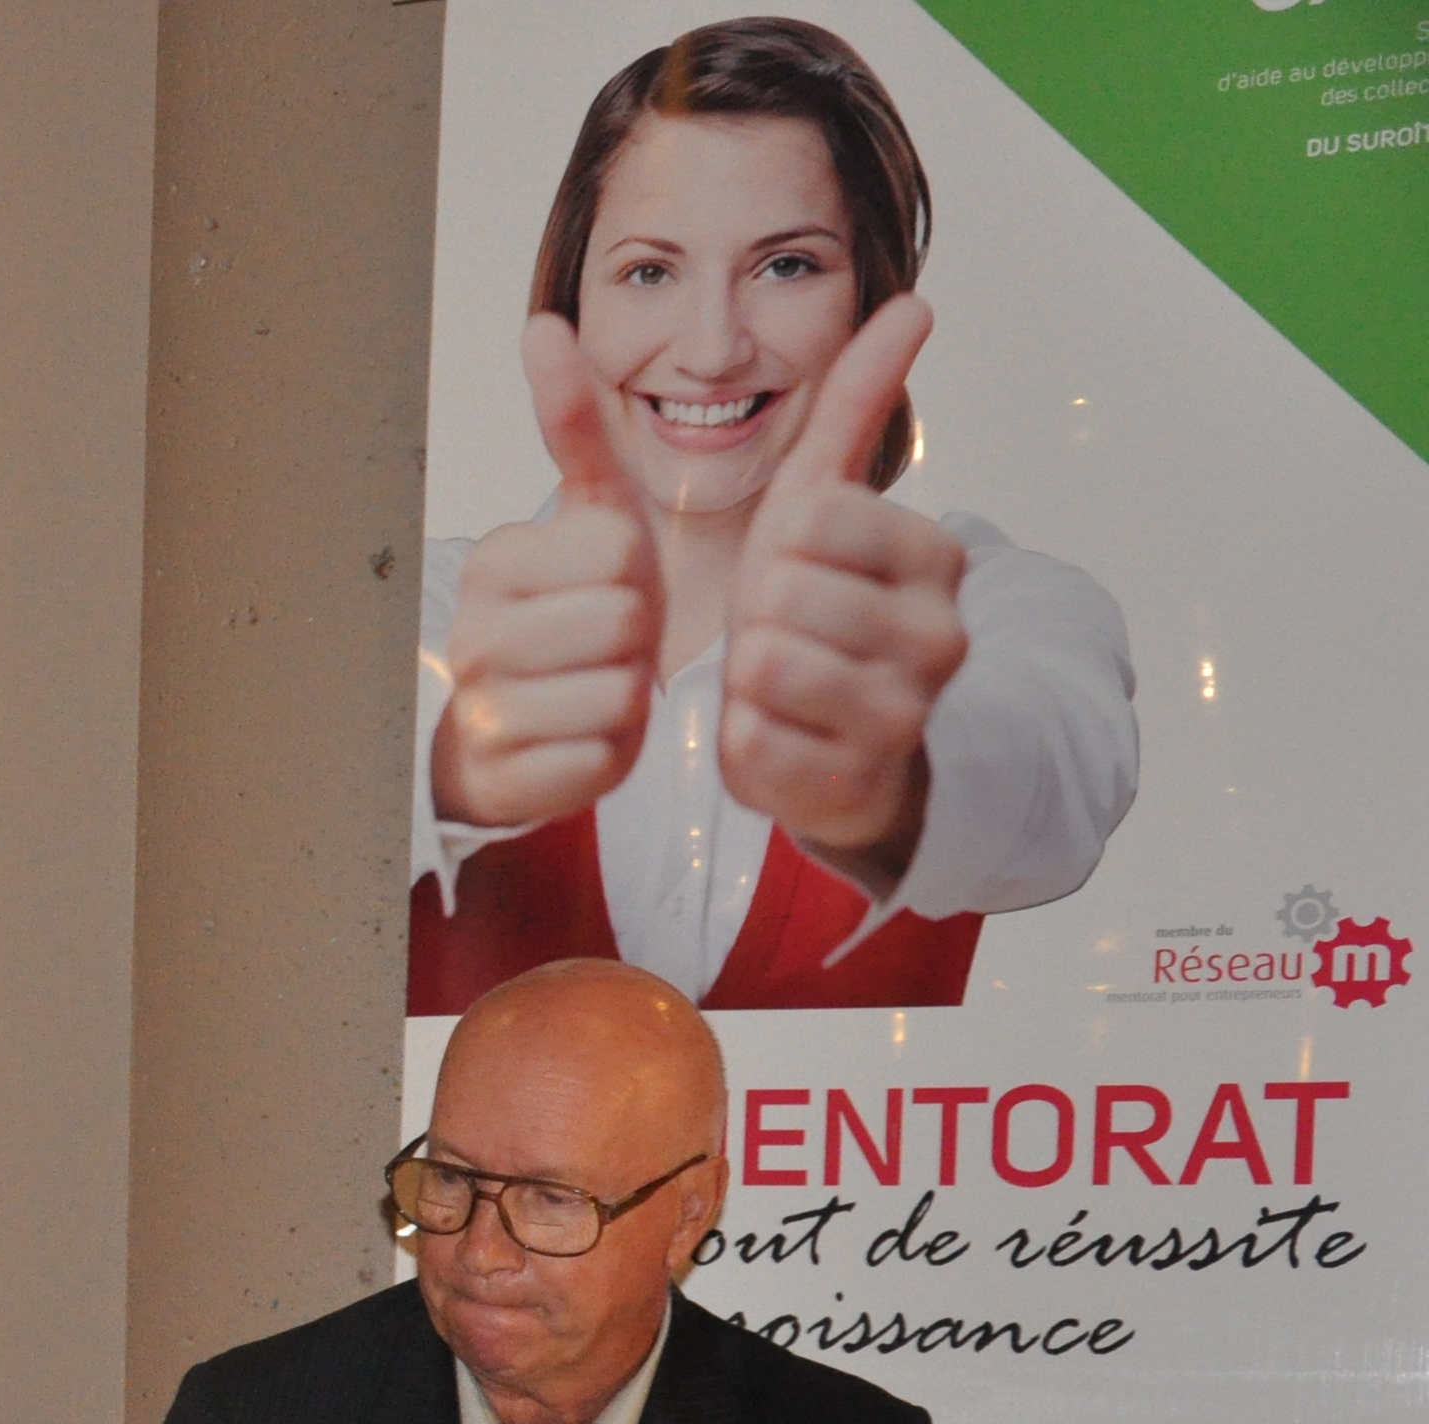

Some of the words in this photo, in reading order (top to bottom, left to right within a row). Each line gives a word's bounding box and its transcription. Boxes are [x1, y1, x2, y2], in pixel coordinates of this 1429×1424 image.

[1290, 66, 1315, 82] au
[1321, 87, 1357, 106] des
[1306, 135, 1340, 157] DU
[1156, 925, 1211, 938] membre
[1216, 924, 1233, 937] du
[1153, 945, 1303, 983] Réseau
[1171, 991, 1201, 1005] pour
[720, 1080, 1350, 1188] ENTORAT
[866, 1190, 970, 1268] de
[996, 1194, 1367, 1270] réussite
